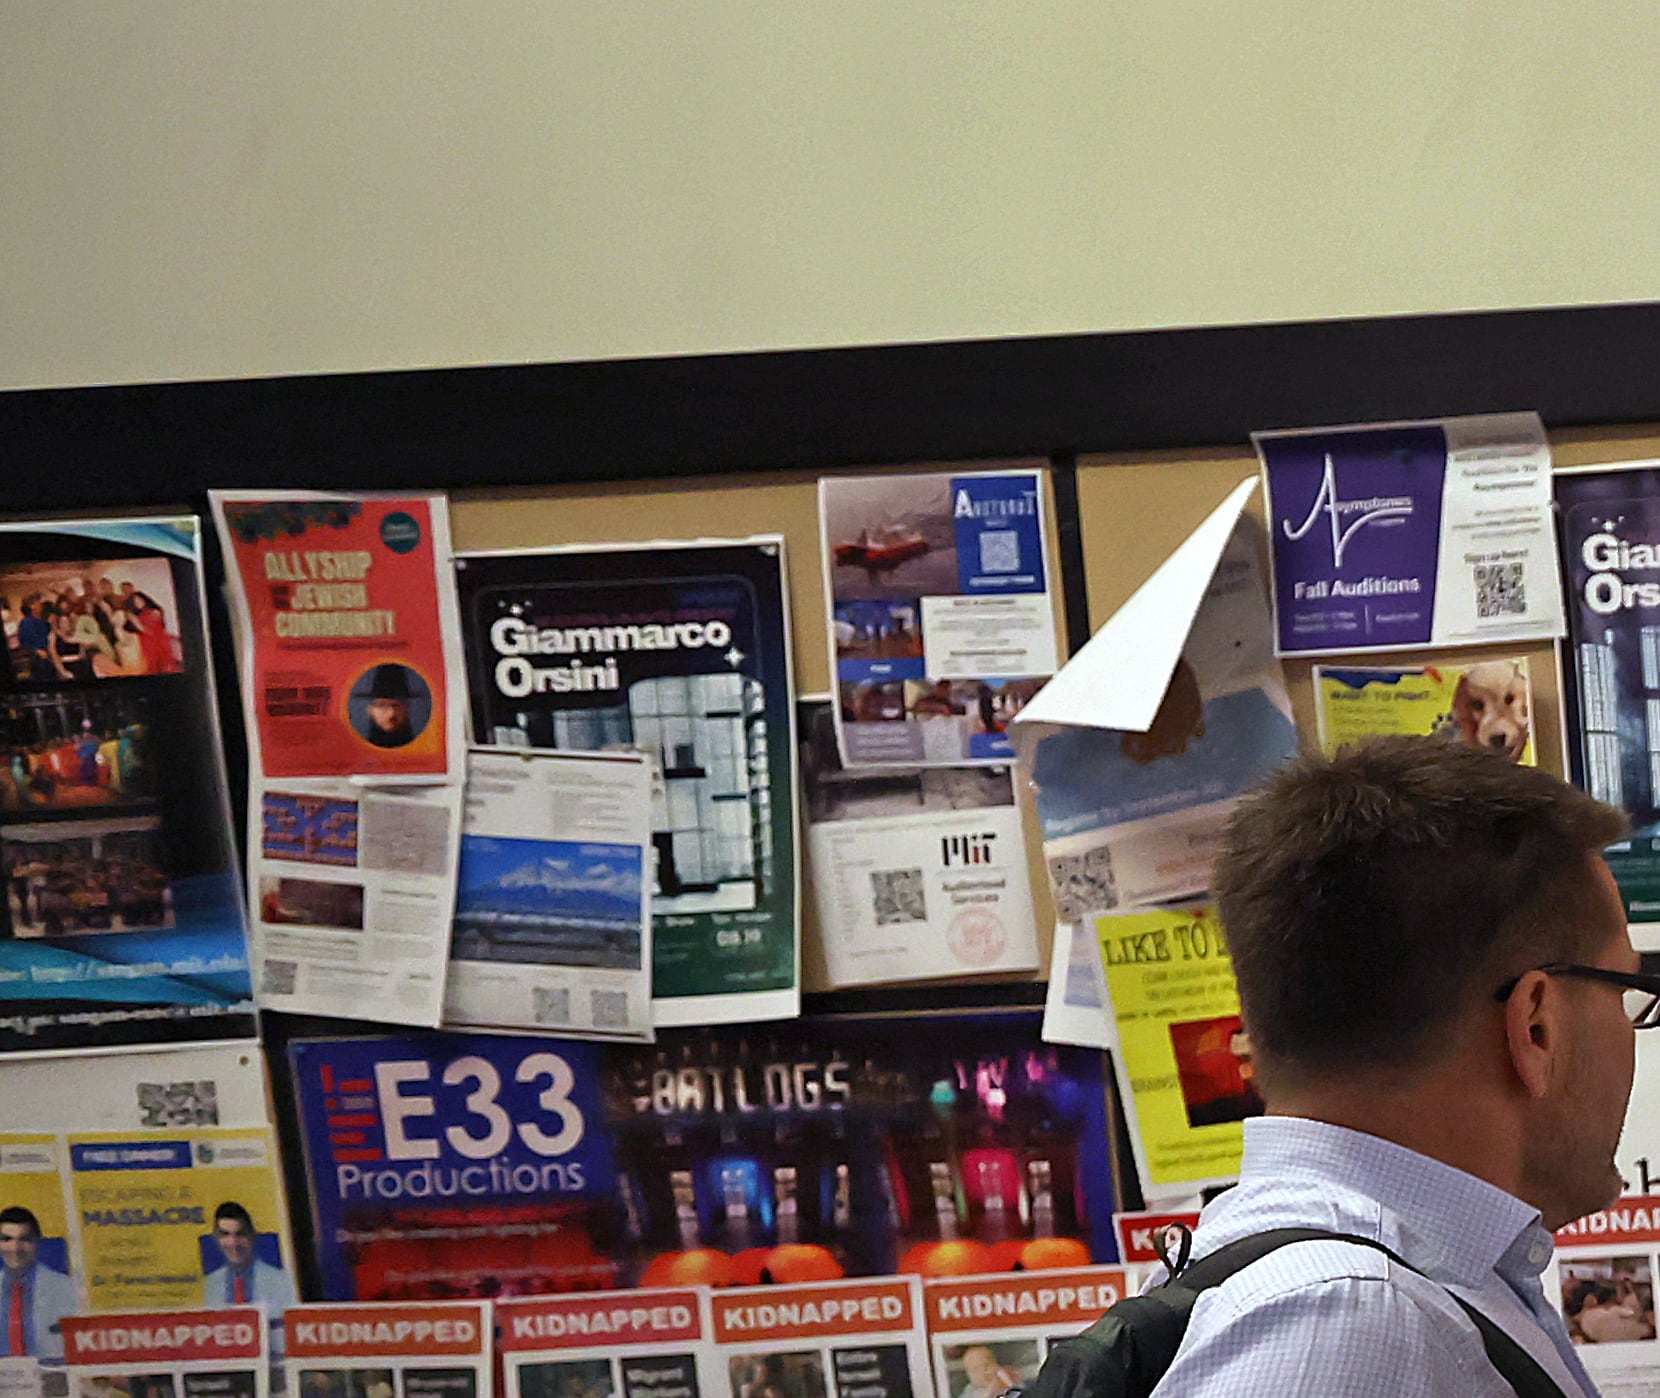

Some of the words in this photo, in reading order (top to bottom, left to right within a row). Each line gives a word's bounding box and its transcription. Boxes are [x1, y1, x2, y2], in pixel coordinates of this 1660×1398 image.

[264, 551, 373, 580] ALLYSHIP
[1294, 580, 1328, 599] Fall
[1331, 577, 1420, 596] Auditions
[491, 616, 731, 653] Giammarco
[496, 658, 619, 697] Orsini
[1103, 931, 1170, 966] LIKE
[1174, 925, 1209, 960] TO
[374, 1052, 585, 1160] E33
[338, 1157, 586, 1198] Productions
[723, 1297, 903, 1329] KIDNAPPED
[938, 1284, 1118, 1321] KIDNAPPED
[74, 1323, 254, 1352] KIDNAPPED
[296, 1320, 476, 1346] KIDNAPPED
[513, 1305, 692, 1339] KIDNAPPED
